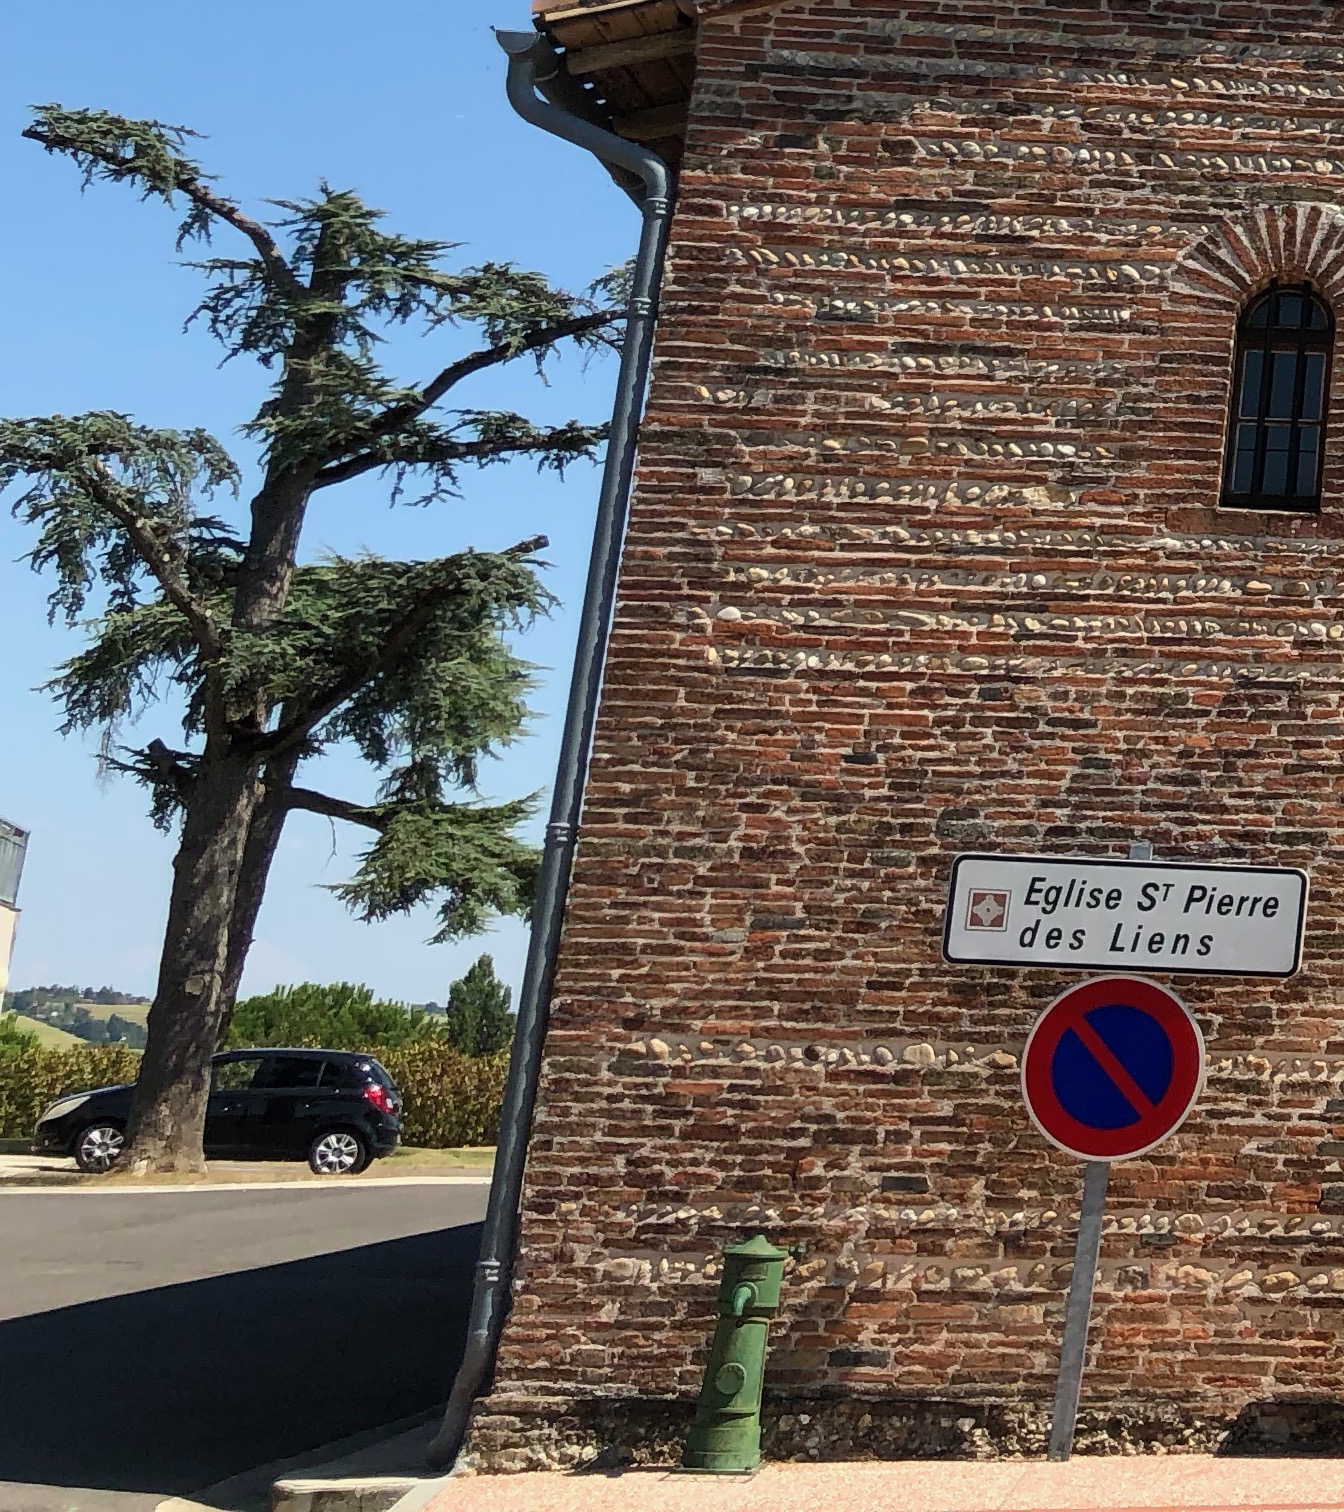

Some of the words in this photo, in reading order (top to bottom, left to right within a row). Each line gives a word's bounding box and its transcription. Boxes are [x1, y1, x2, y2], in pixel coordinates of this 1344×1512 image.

[1023, 876, 1122, 915] Eglise
[1183, 884, 1280, 918] Pierre
[1018, 919, 1087, 951] des
[1109, 922, 1214, 956] Liens
